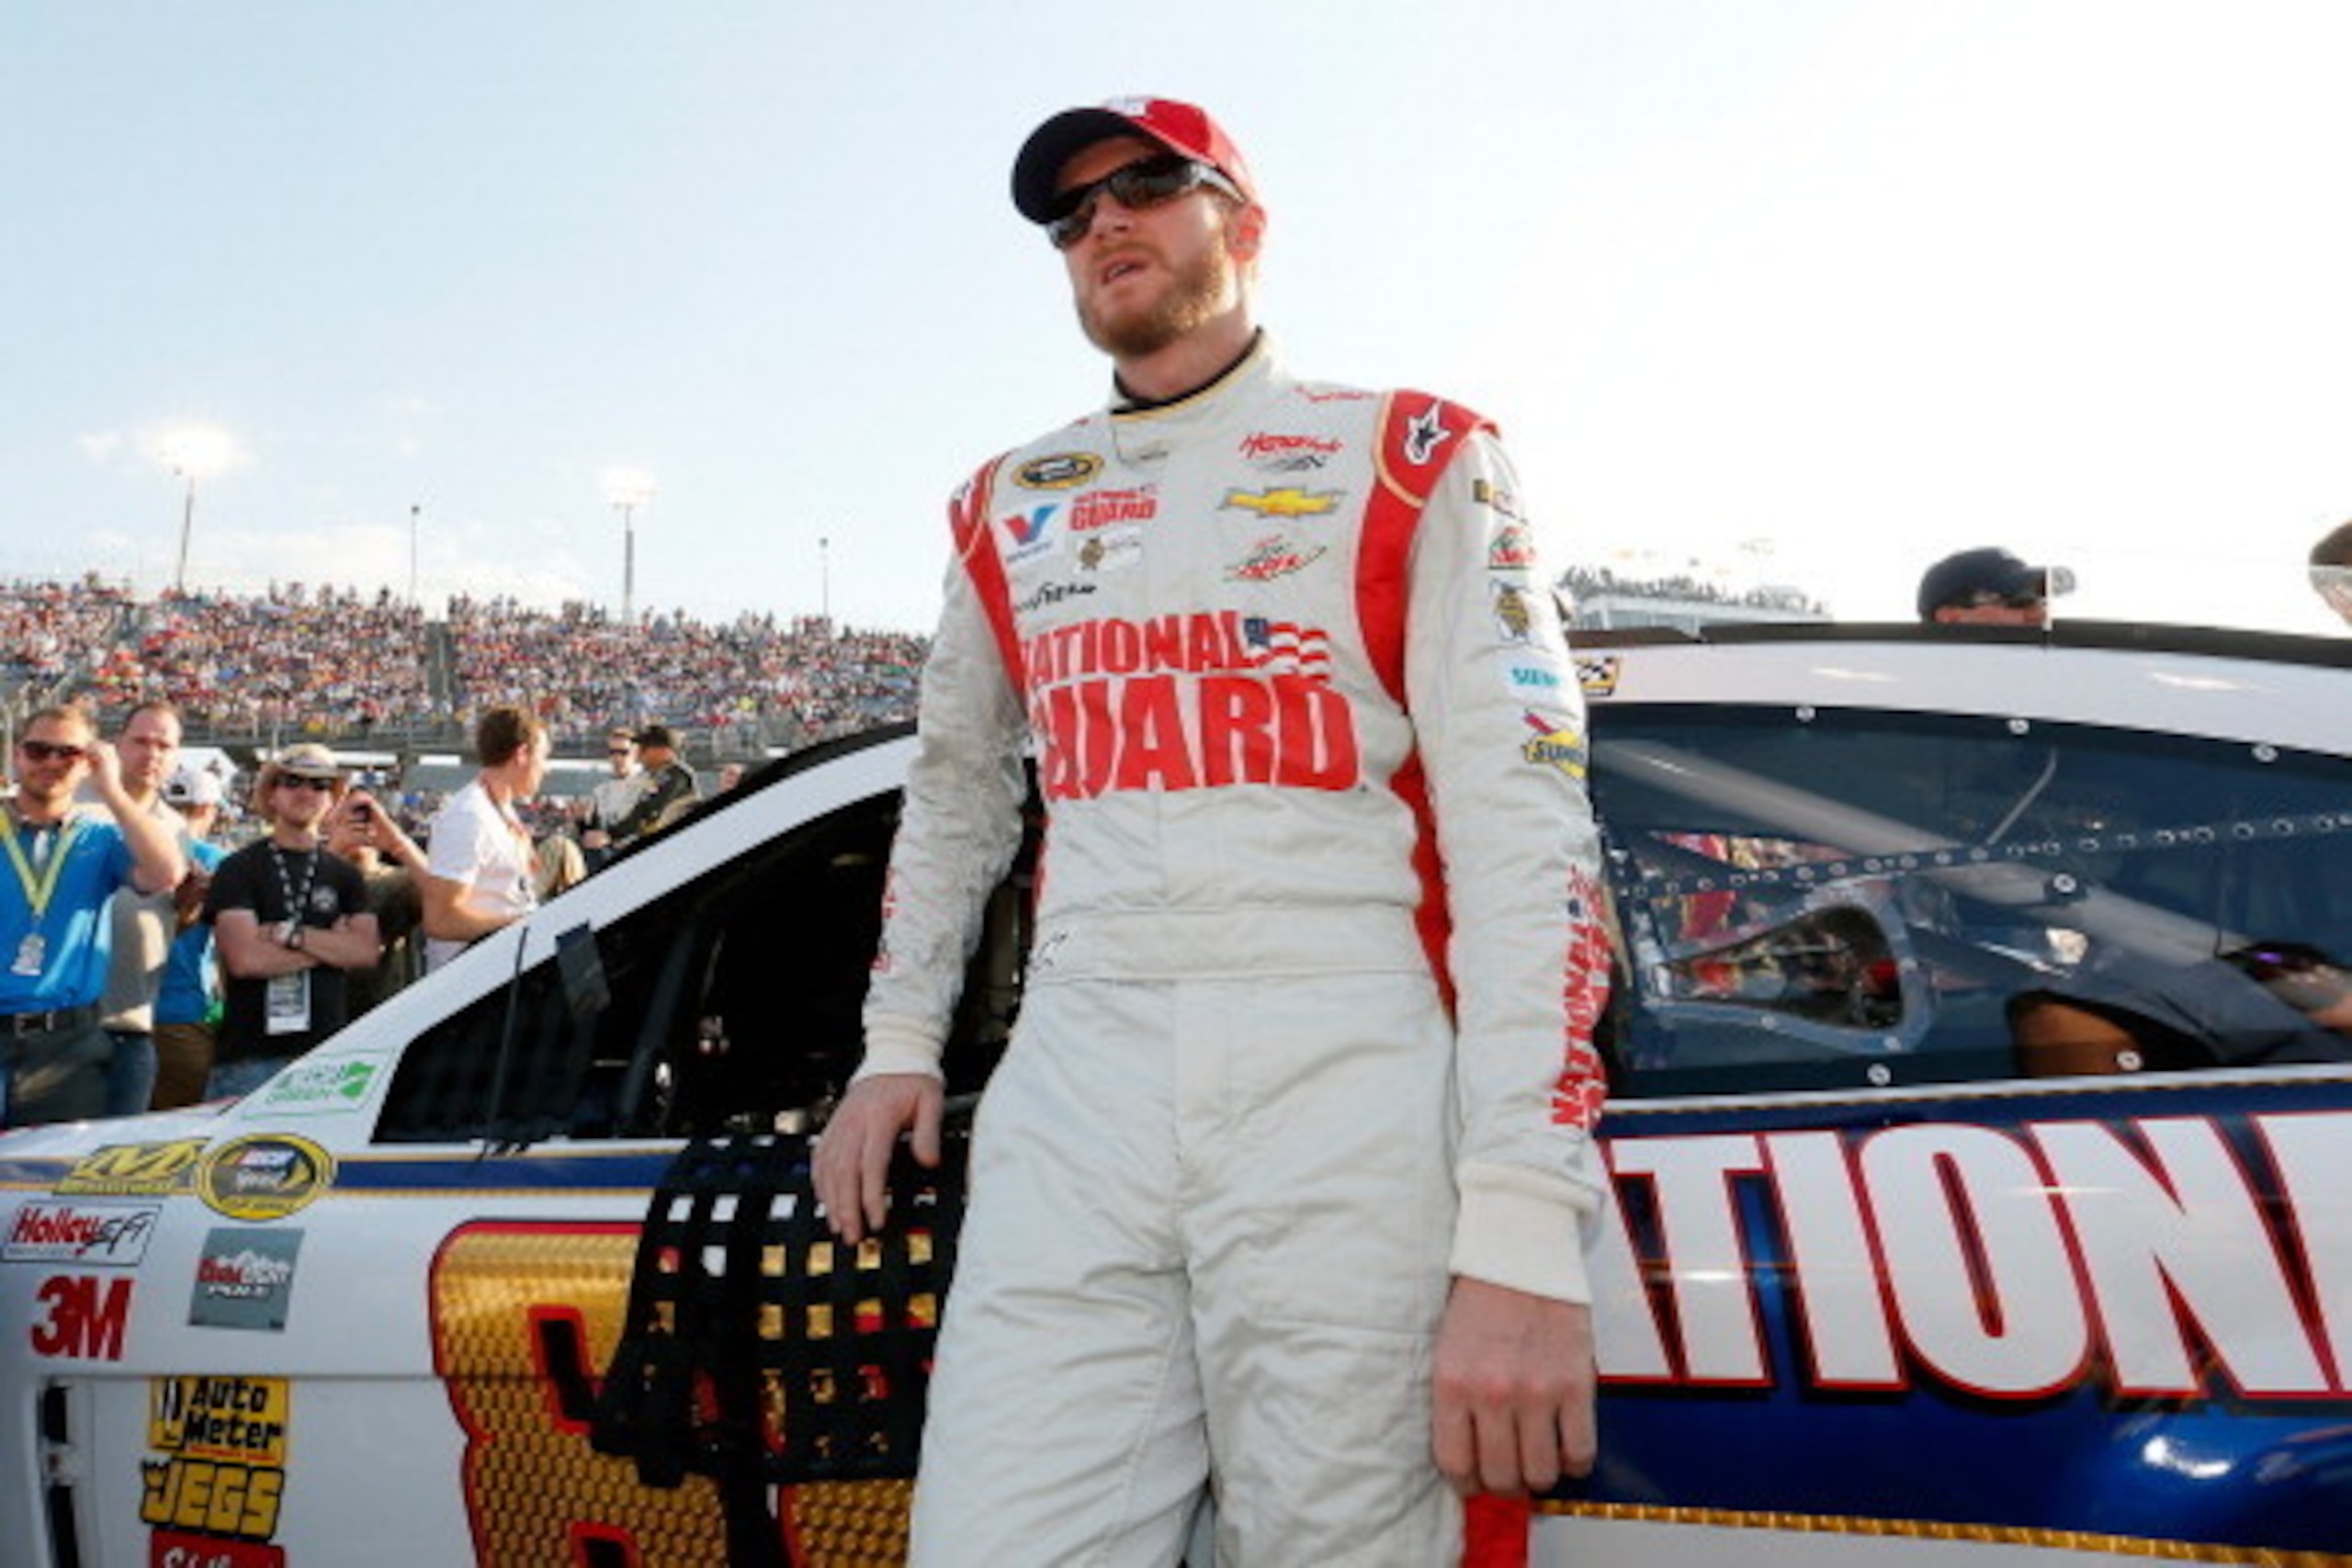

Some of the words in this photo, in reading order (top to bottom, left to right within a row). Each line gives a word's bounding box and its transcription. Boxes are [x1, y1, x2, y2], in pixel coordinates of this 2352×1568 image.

[1069, 499, 1158, 533] GUARD
[1023, 611, 1250, 691] ATIONAL
[9, 1207, 103, 1245] Holley
[31, 1275, 135, 1360] 3M
[191, 1379, 269, 1413] Auto
[184, 1411, 284, 1449] Meter
[141, 1455, 285, 1543] JEGS
